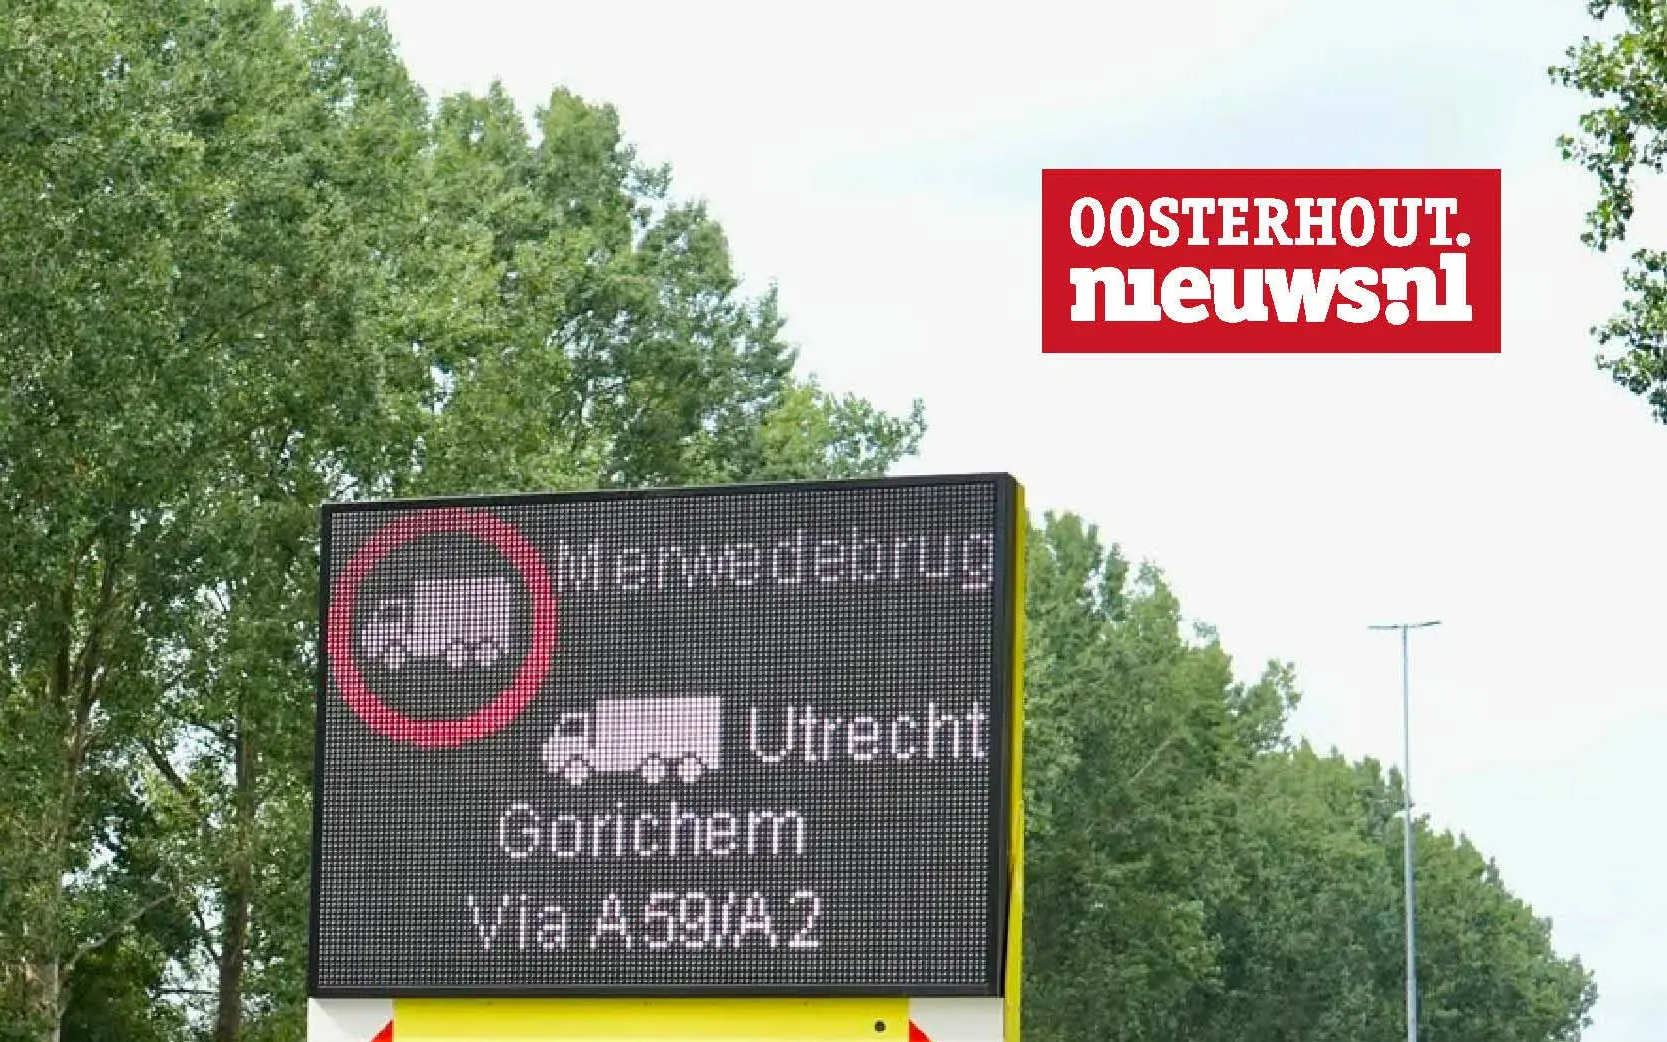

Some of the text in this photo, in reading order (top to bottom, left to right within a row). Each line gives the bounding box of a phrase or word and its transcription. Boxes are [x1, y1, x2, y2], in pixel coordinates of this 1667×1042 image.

[557, 525, 995, 592] Merwedebrug
[748, 702, 989, 764] Utrecht
[499, 801, 806, 860] Gorichem
[467, 891, 566, 952] Via
